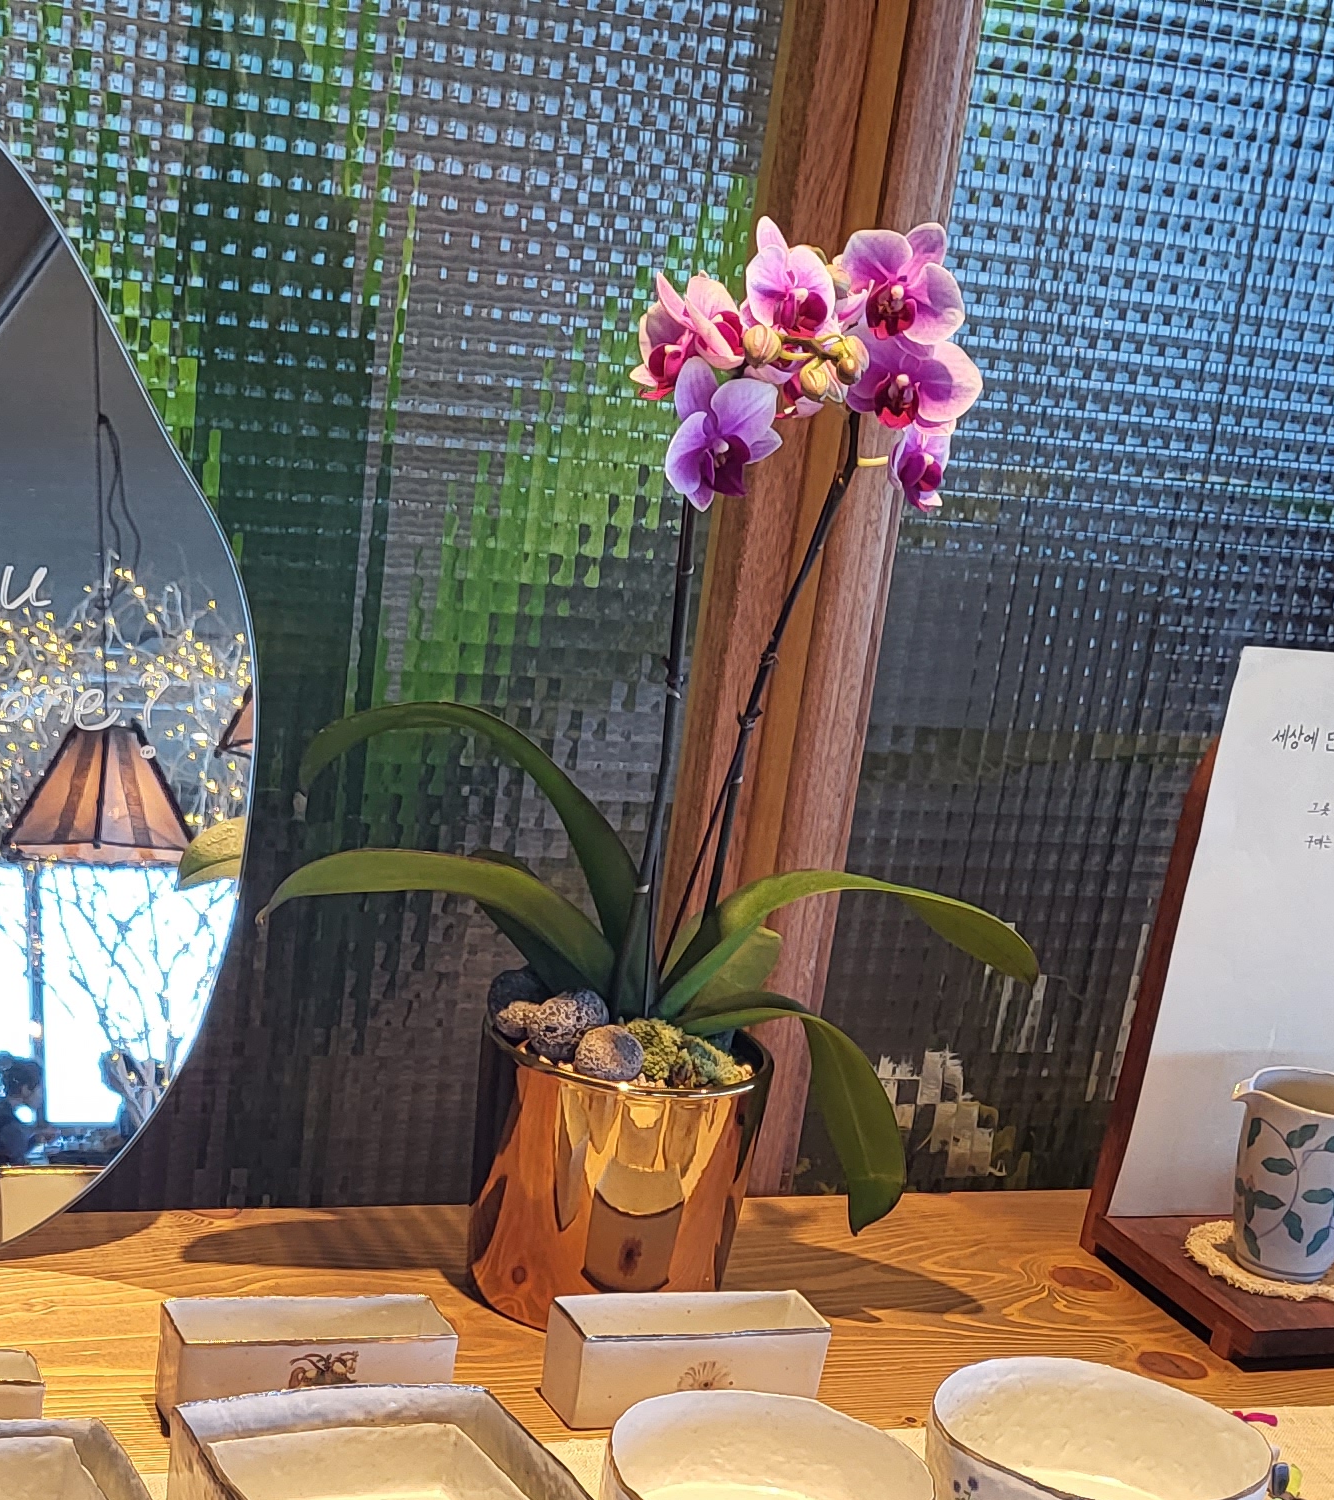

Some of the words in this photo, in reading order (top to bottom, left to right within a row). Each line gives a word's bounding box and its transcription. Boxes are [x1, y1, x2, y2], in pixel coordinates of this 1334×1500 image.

[1270, 723, 1320, 753] 세상에
[1306, 801, 1331, 817] 그릇
[1304, 834, 1333, 850] 구매는
